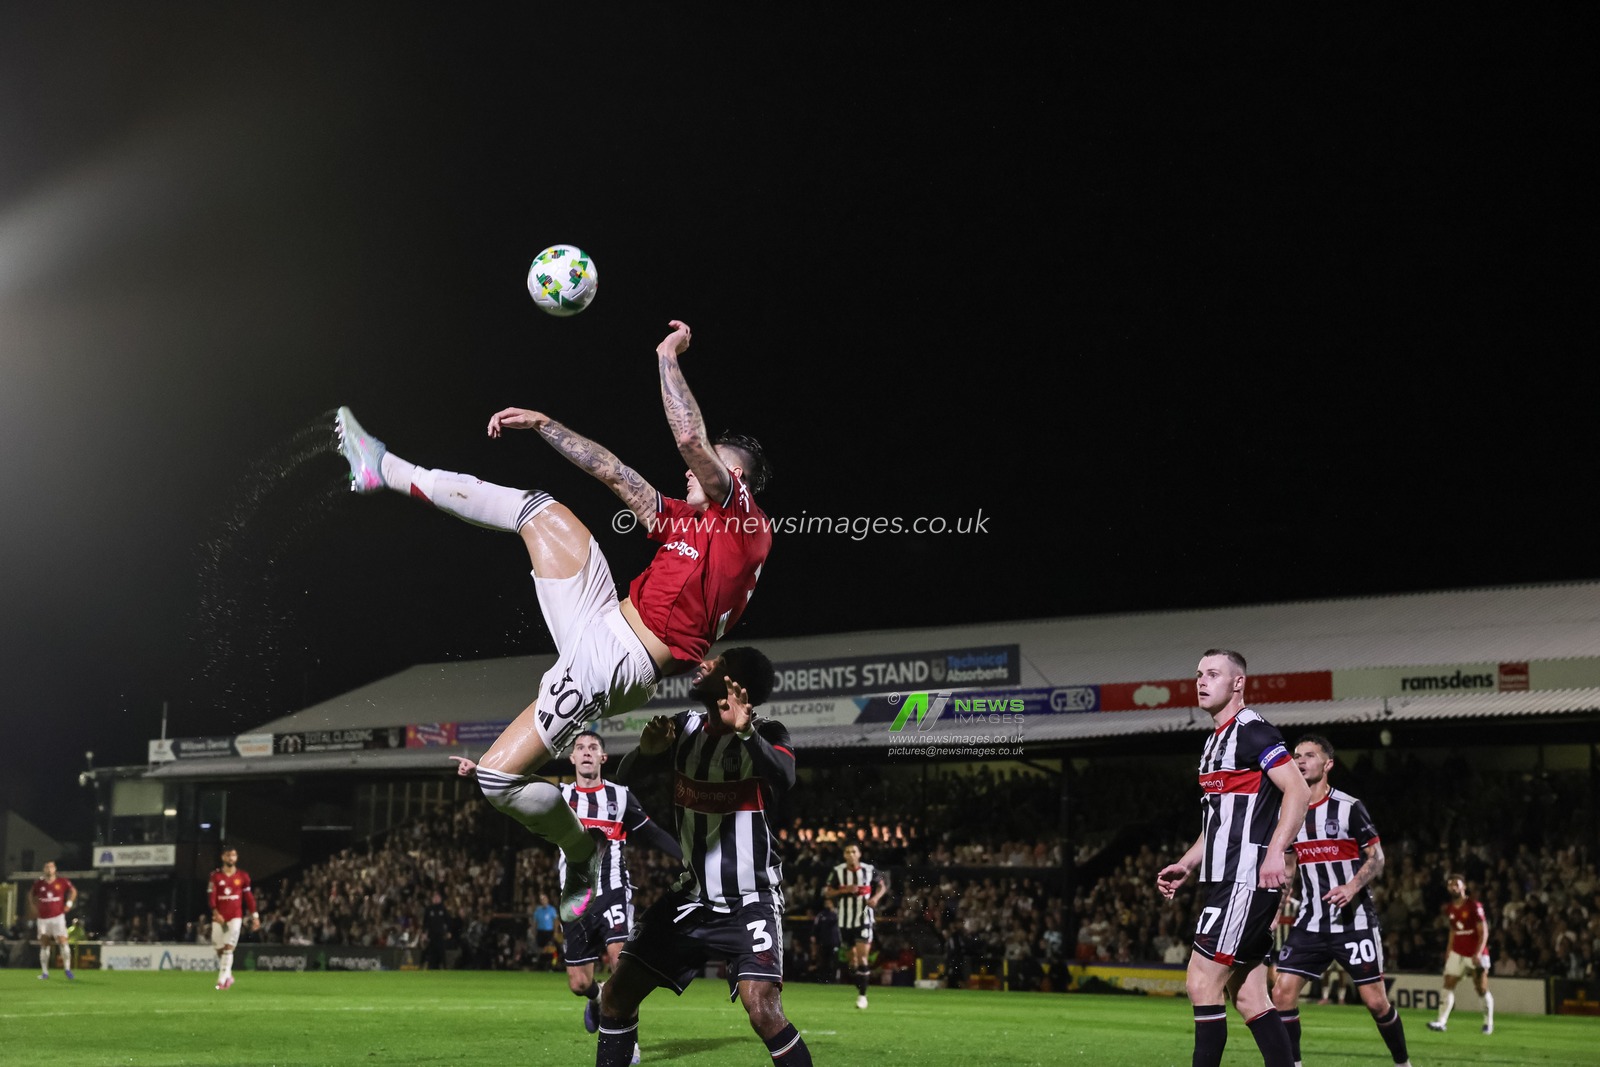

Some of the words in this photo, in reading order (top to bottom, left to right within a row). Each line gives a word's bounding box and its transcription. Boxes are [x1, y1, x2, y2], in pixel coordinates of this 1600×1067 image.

[947, 652, 1008, 667] Technical
[772, 665, 857, 693] ORBENTS
[862, 661, 929, 687] STAND
[946, 667, 1009, 682] Absorbents
[1401, 669, 1494, 691] ramsdens
[769, 702, 836, 717] BLACKROW
[603, 903, 626, 929] 15
[746, 919, 774, 953] 3
[1344, 938, 1377, 966] 20
[1396, 989, 1441, 1010] DFD
